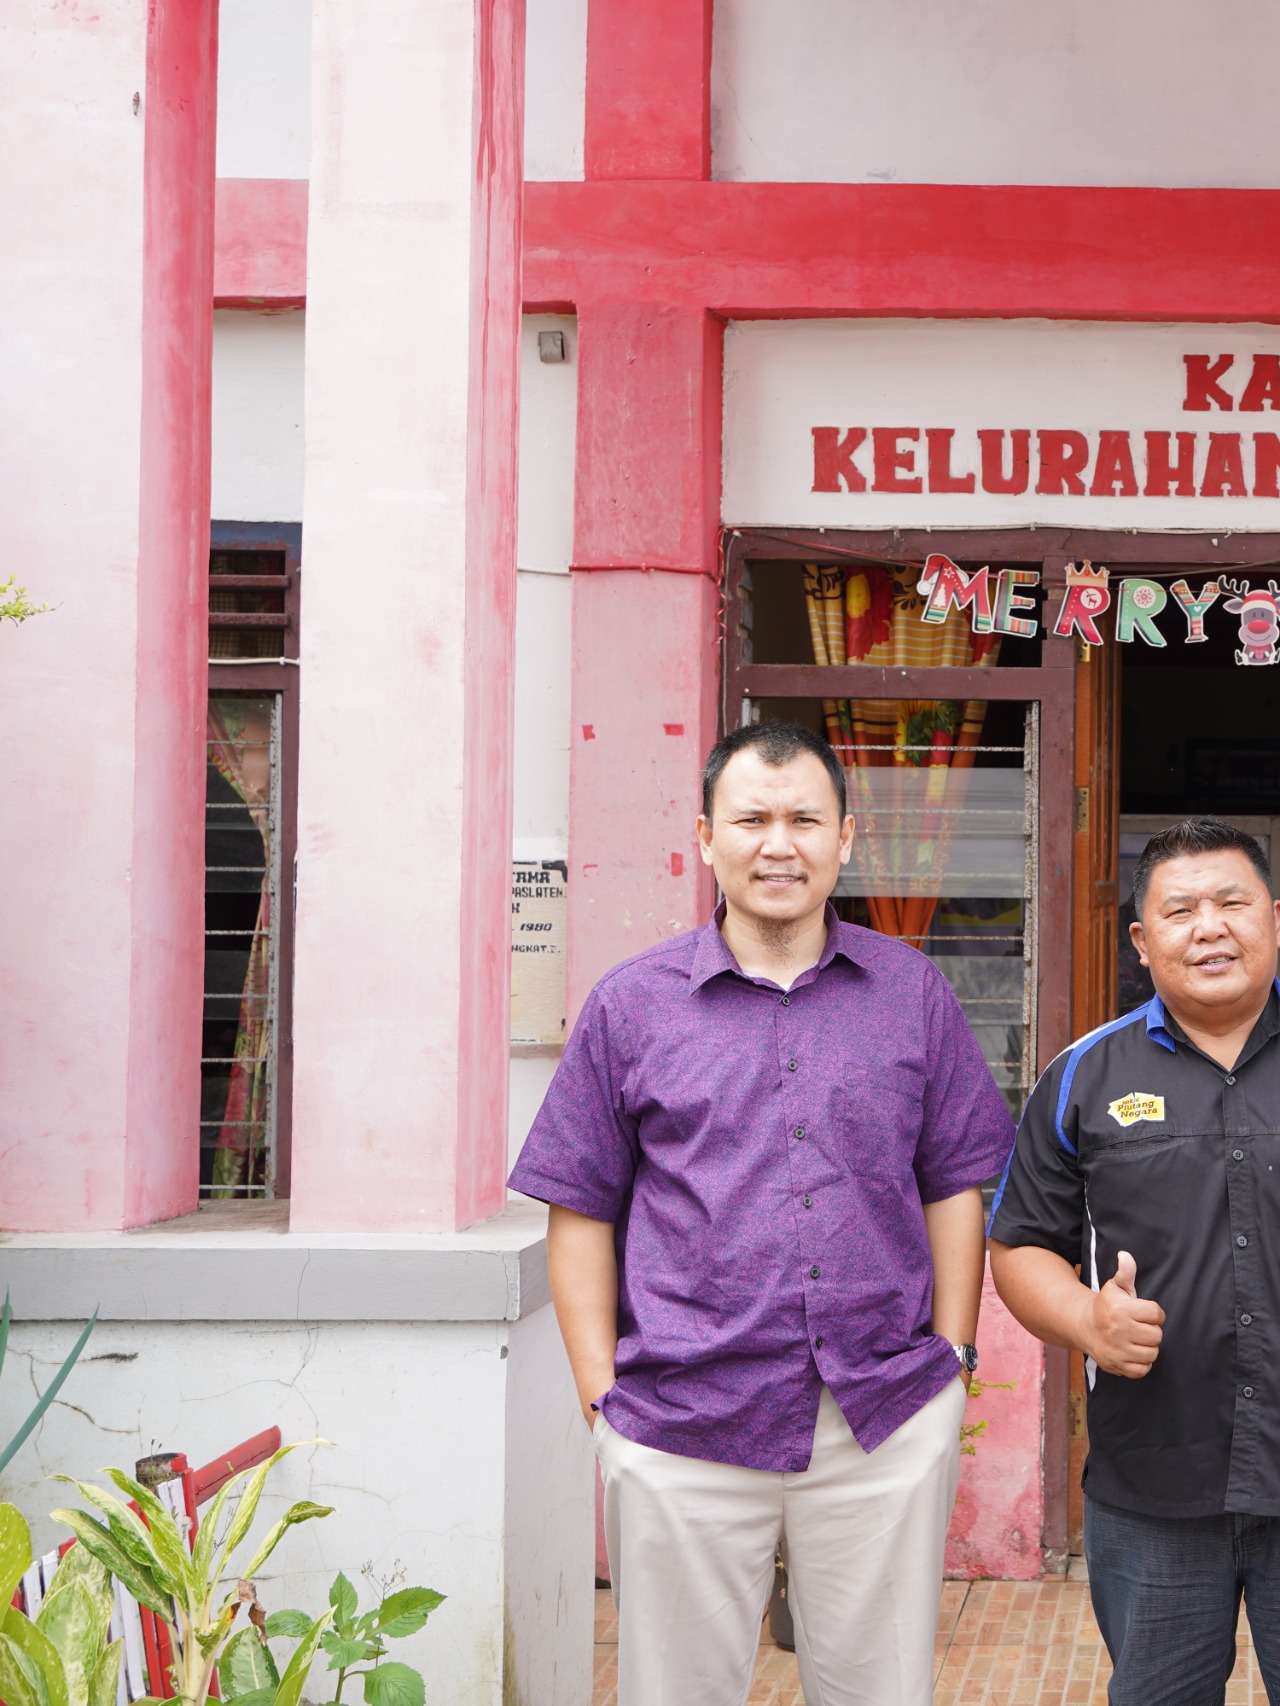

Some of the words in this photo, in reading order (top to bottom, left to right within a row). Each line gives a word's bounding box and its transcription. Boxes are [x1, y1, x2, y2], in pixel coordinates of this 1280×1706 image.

[916, 552, 1220, 648] MERRY
[520, 923, 552, 931] 1980
[1117, 1101, 1155, 1112] Piutang
[1120, 1107, 1158, 1119] Negara
